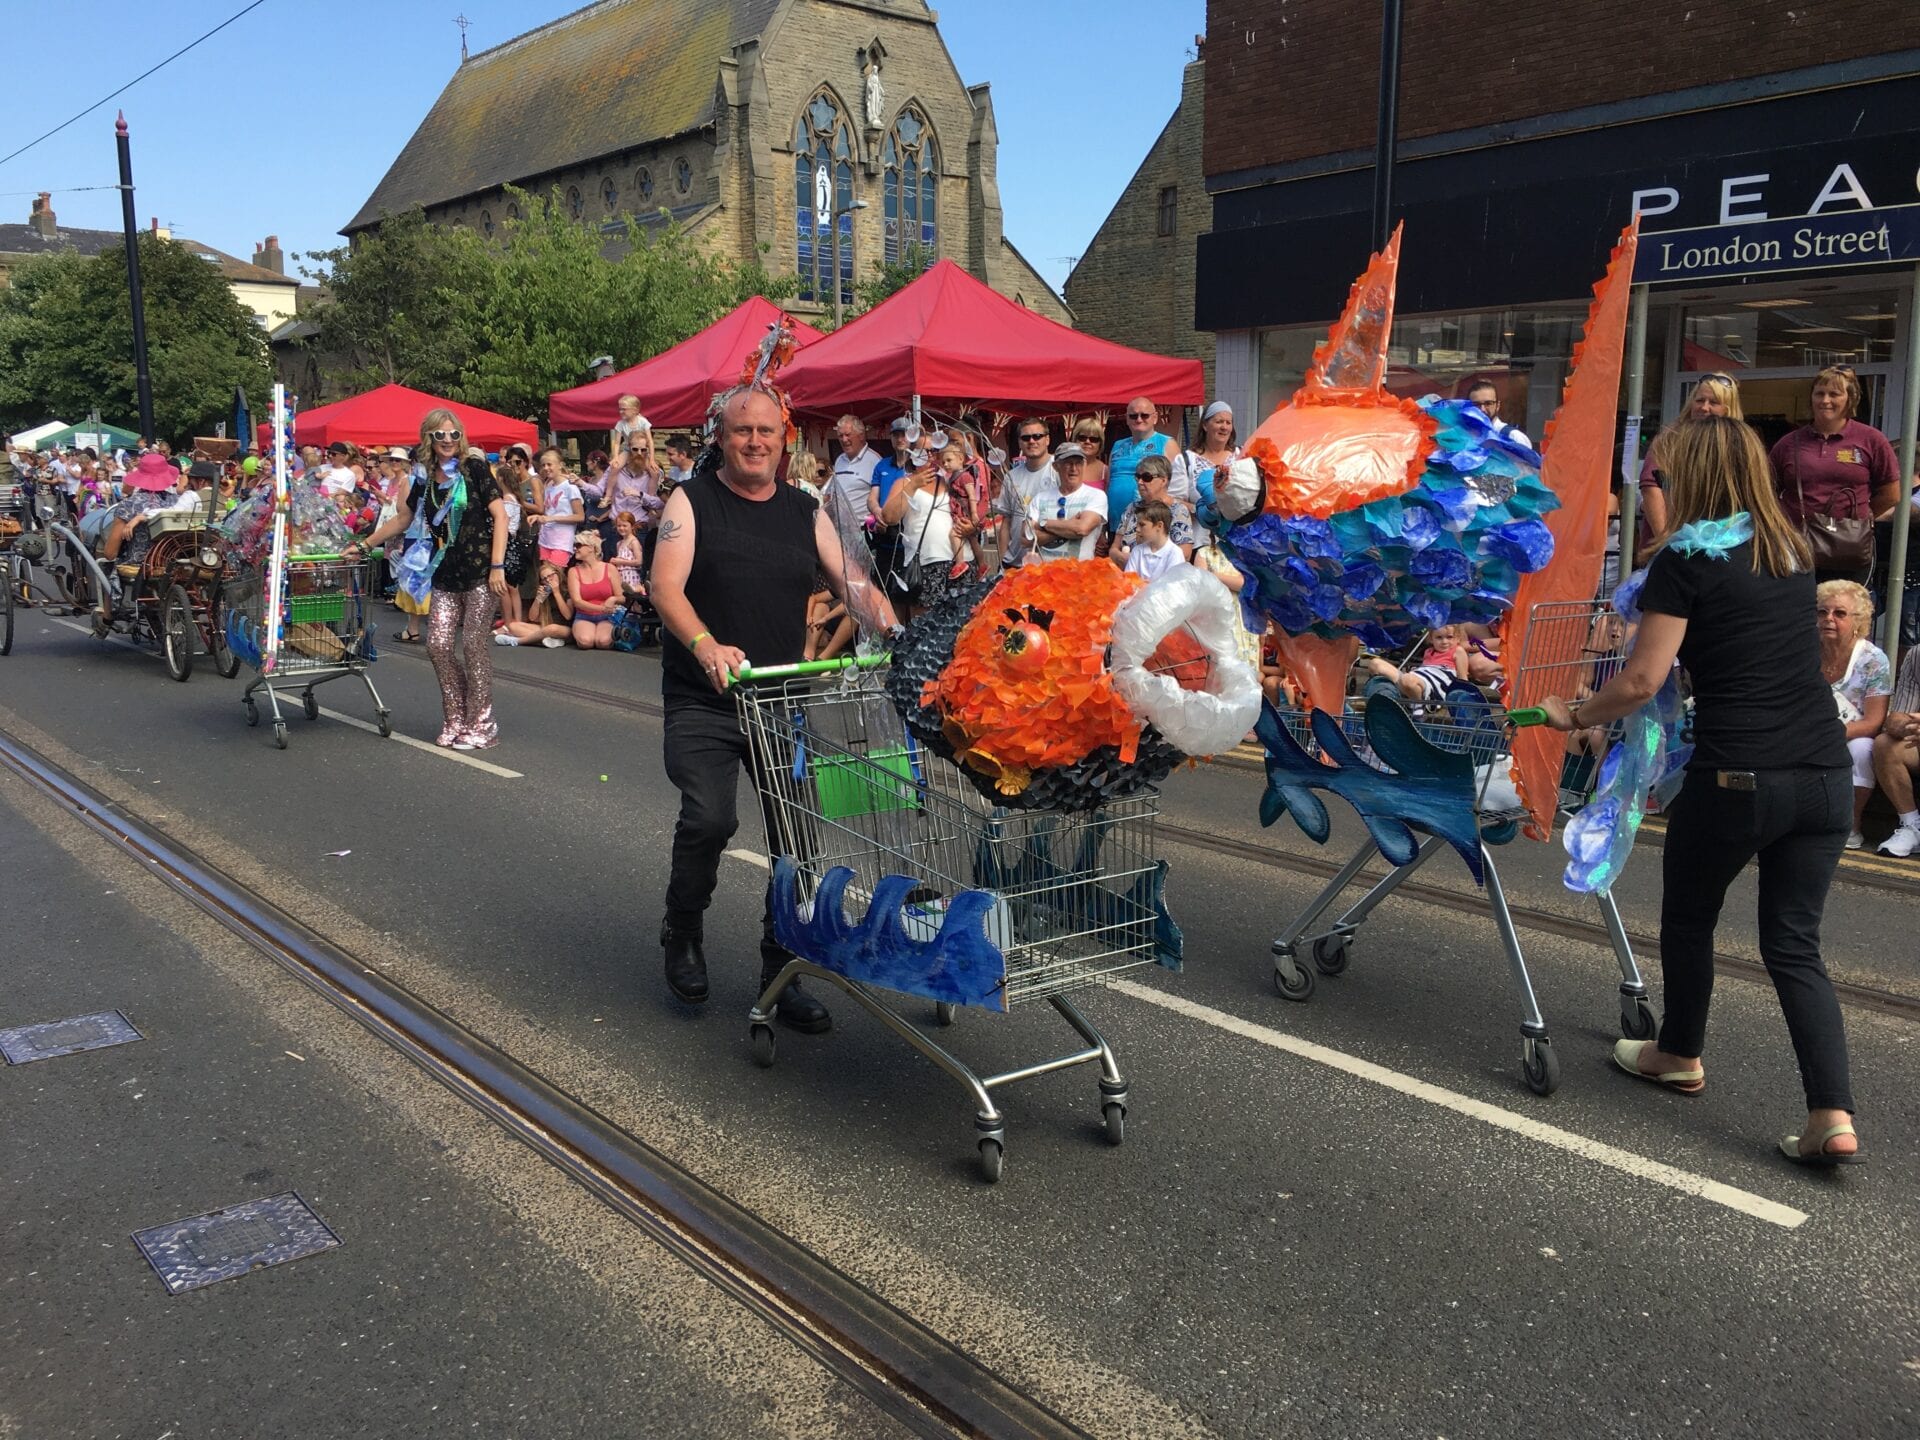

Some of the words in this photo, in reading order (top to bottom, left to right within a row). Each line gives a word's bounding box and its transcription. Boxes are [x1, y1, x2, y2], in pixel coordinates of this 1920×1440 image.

[1631, 163, 1920, 225] PEA
[1660, 235, 1782, 271] London
[1792, 224, 1890, 259] Street
